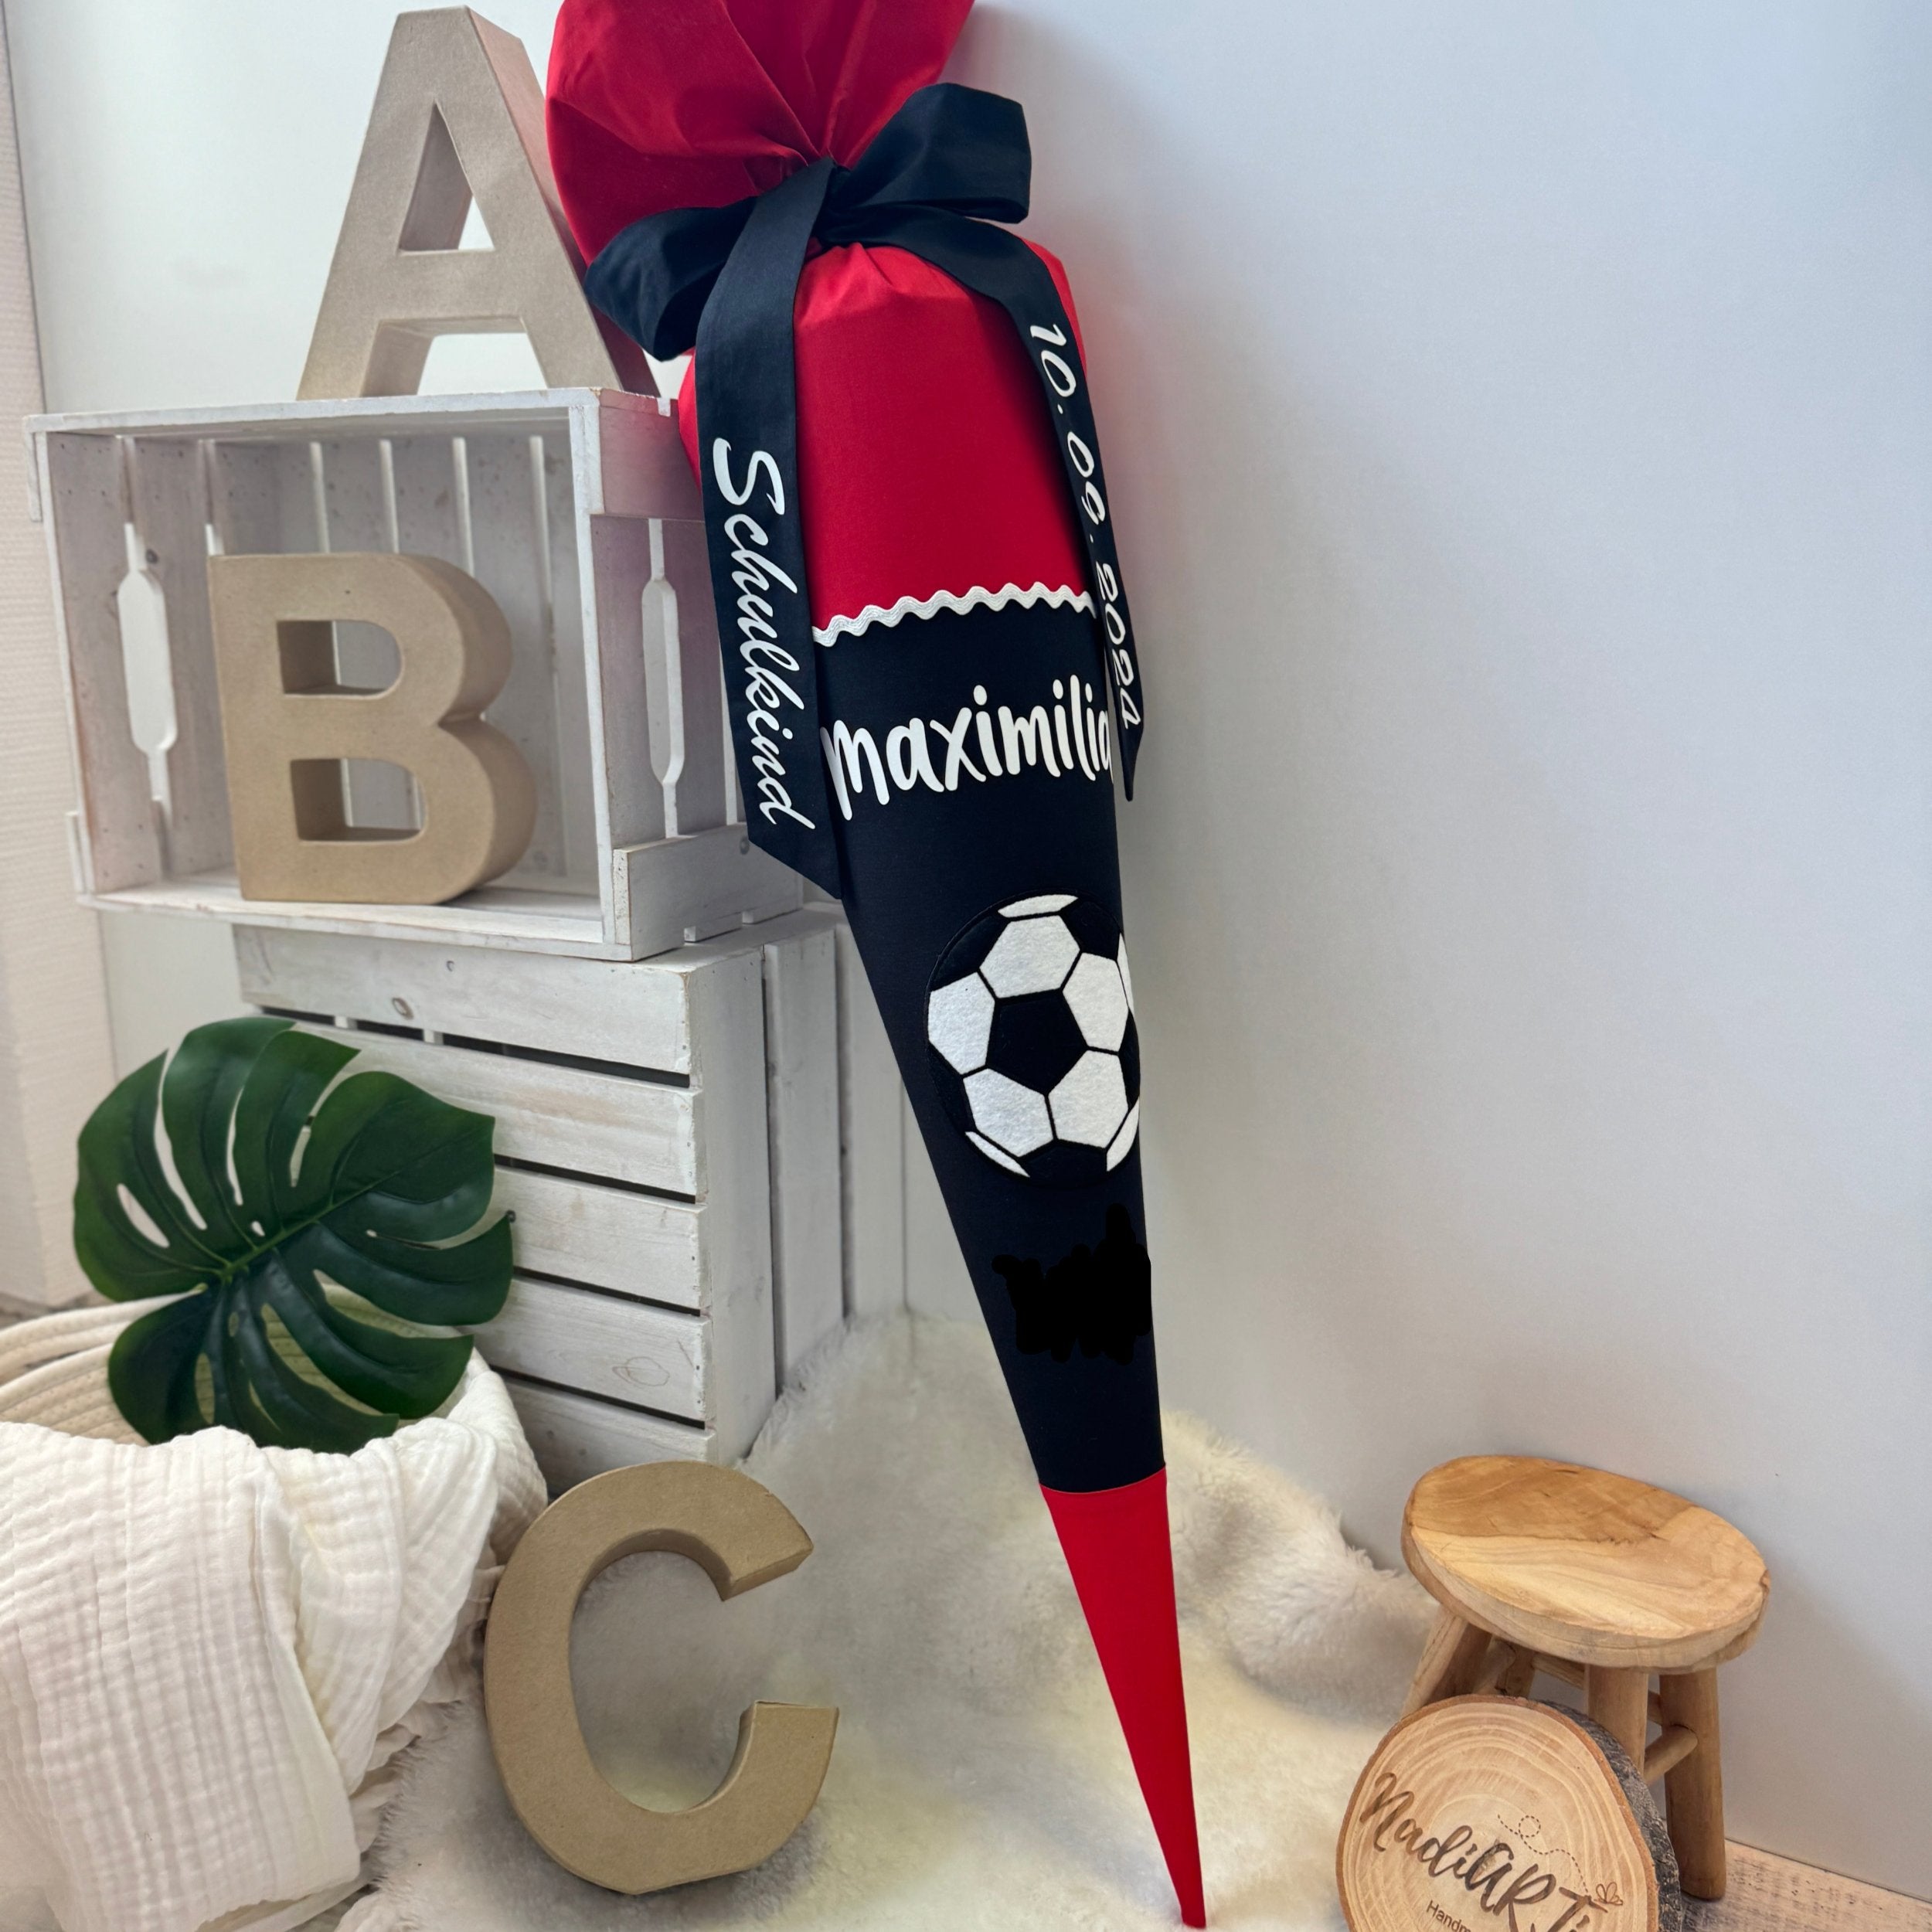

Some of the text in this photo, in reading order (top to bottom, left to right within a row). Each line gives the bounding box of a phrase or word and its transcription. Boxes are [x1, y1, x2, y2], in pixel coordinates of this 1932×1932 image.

[297, 7, 653, 400] A
[207, 553, 533, 905] B
[712, 437, 816, 831] Schulkind
[483, 1459, 840, 1895] C
